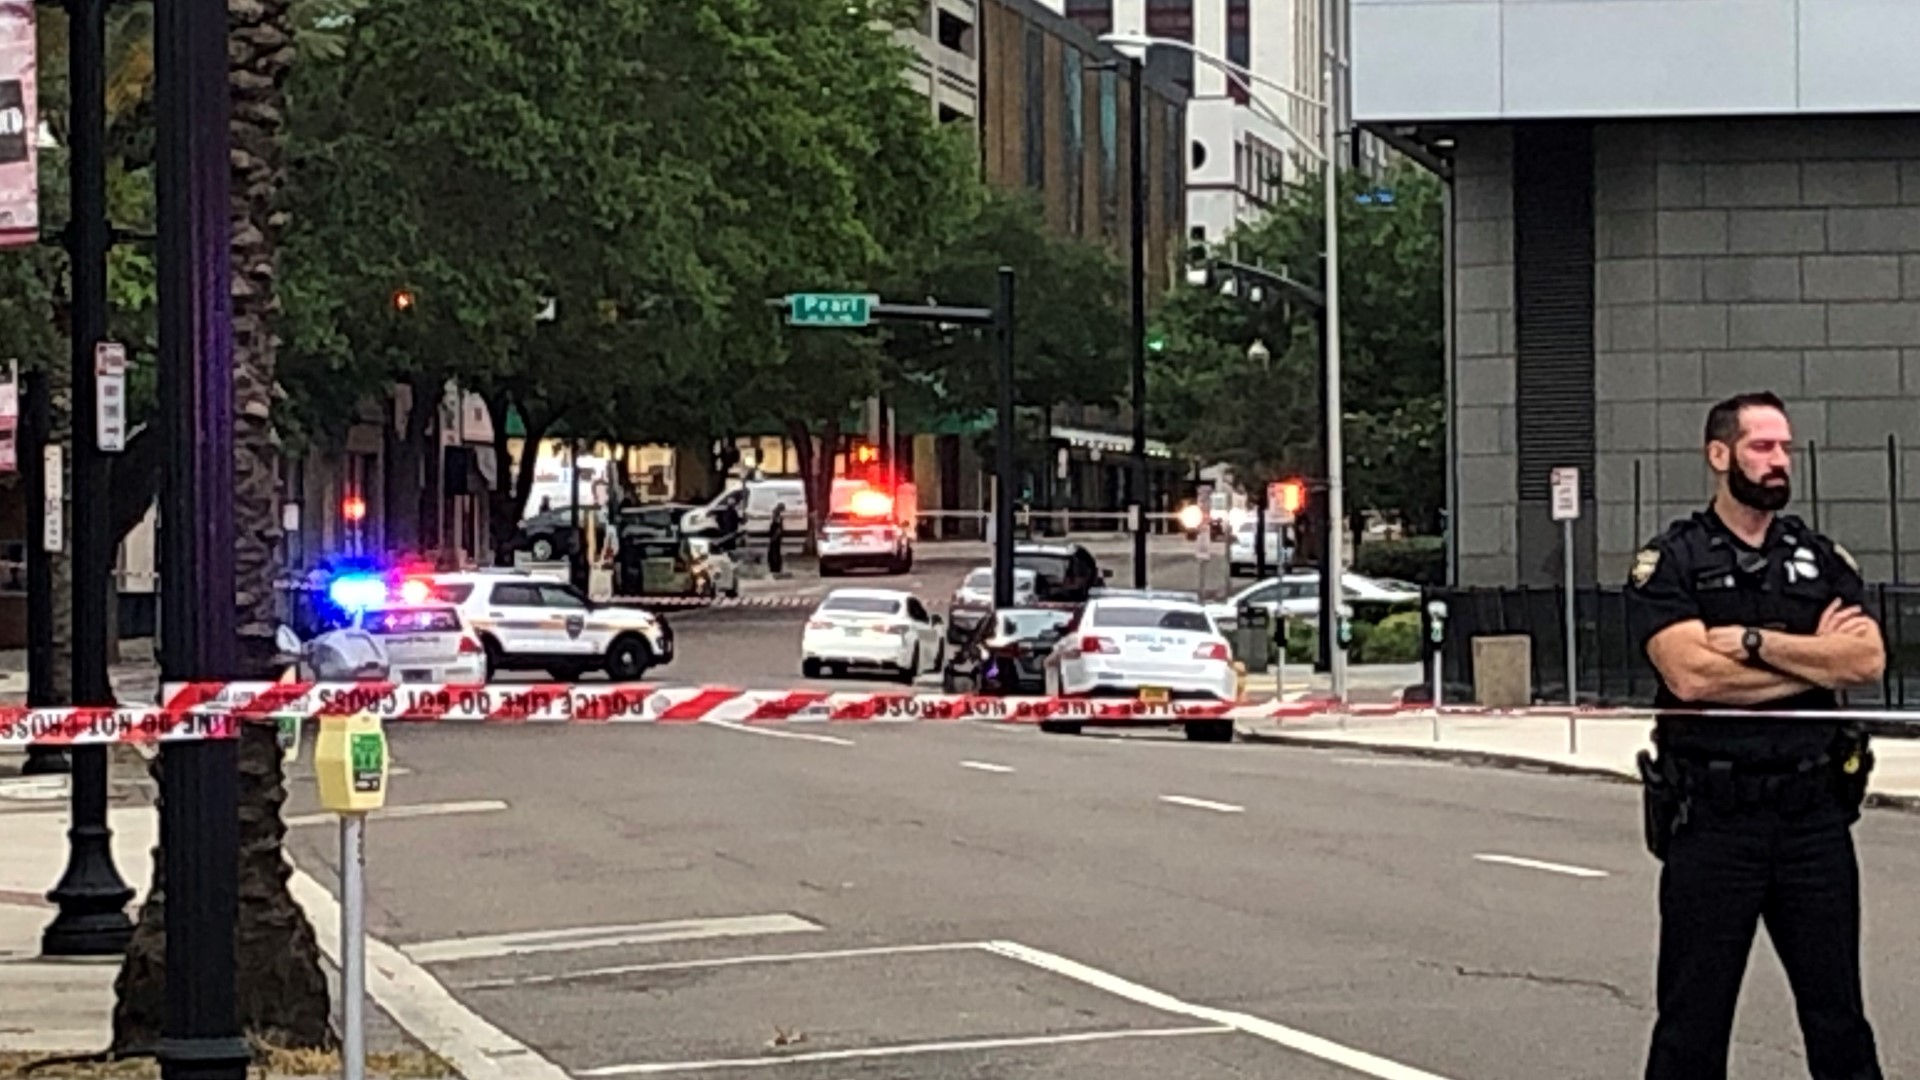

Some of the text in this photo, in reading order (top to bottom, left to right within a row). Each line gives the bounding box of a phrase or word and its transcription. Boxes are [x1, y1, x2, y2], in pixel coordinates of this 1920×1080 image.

[318, 688, 397, 715] CROSS
[407, 690, 450, 715] NOT
[460, 690, 491, 717] DO
[499, 690, 552, 717] LINE
[561, 690, 645, 718] POLICE
[88, 712, 132, 736] NOT
